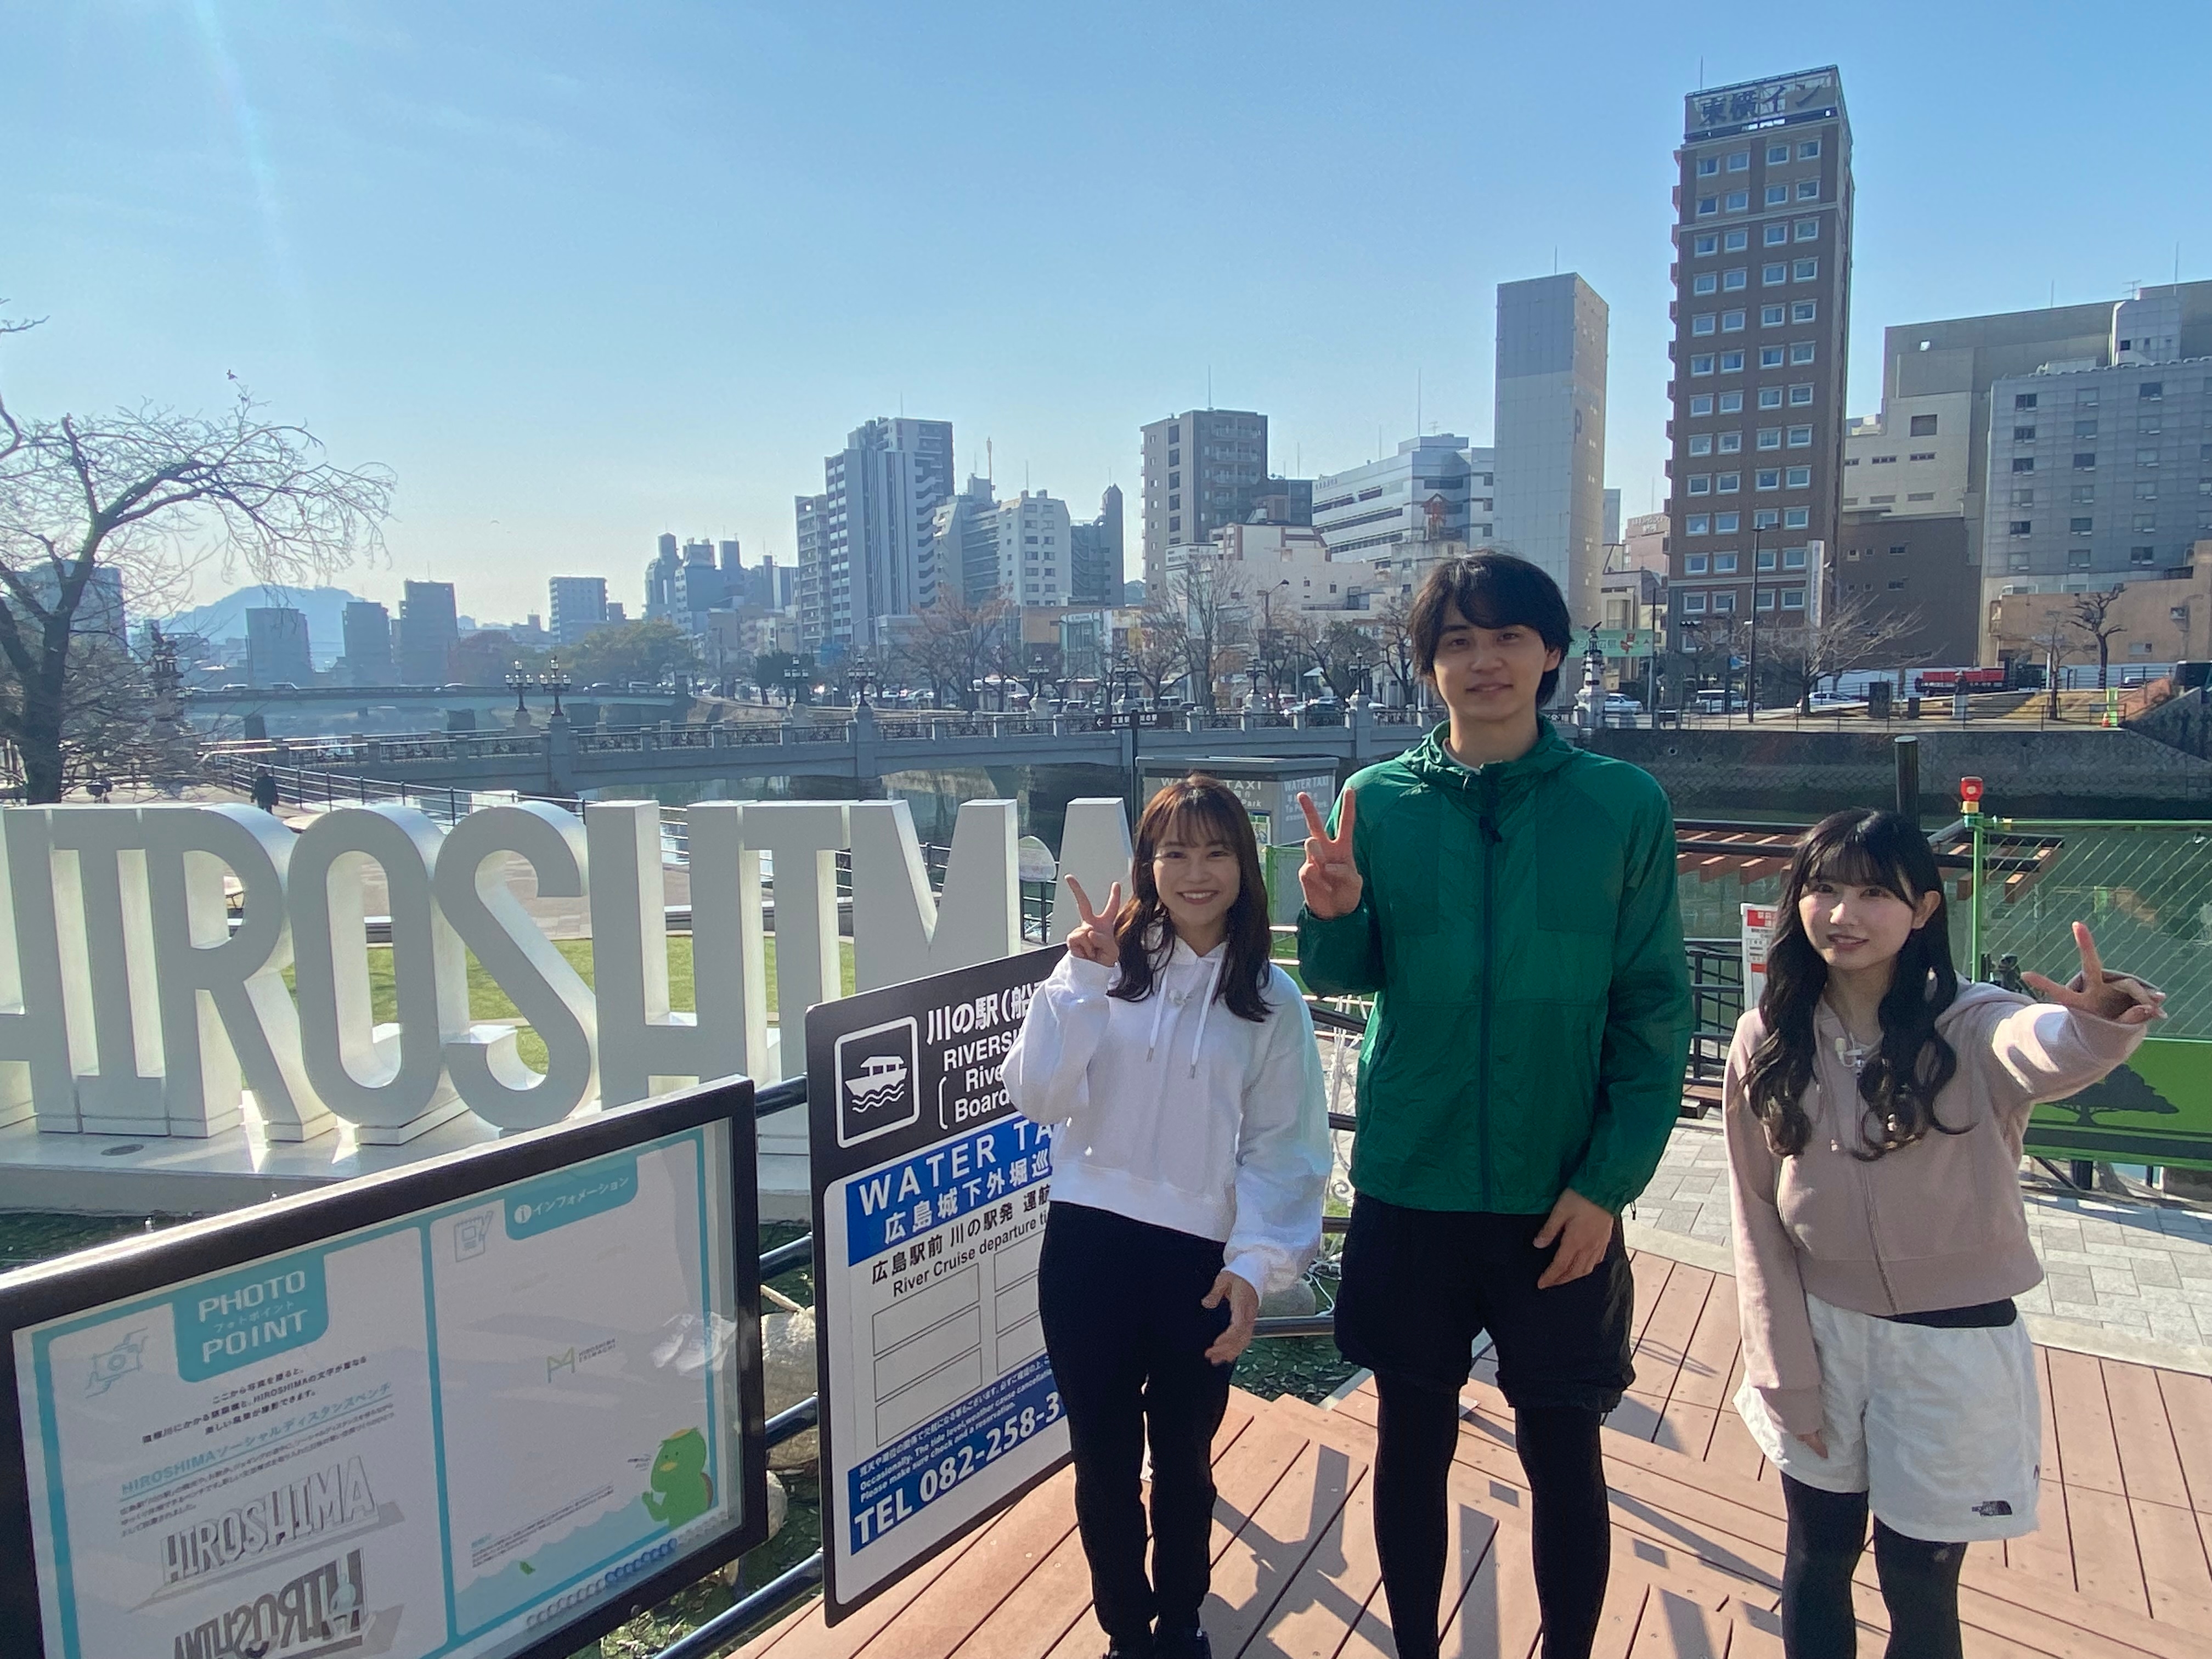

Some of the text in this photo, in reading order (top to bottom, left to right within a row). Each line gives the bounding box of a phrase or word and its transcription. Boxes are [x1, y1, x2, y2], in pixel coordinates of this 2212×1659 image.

[927, 981, 1042, 1045] 川の駅(船
[944, 1028, 1020, 1071] RIVERSI
[859, 1135, 997, 1216] WATER
[872, 1234, 944, 1285] 広島駅前
[950, 1202, 1014, 1248] 川の駅発
[893, 1263, 929, 1298] River
[933, 1248, 976, 1278] Cruise
[979, 1218, 1037, 1256] departure
[198, 1269, 306, 1323] PHOTO
[213, 1301, 295, 1333] フォトポイント
[202, 1309, 308, 1364] POINT
[160, 1455, 380, 1584] HIROSHIMA
[854, 1488, 913, 1545] TEL
